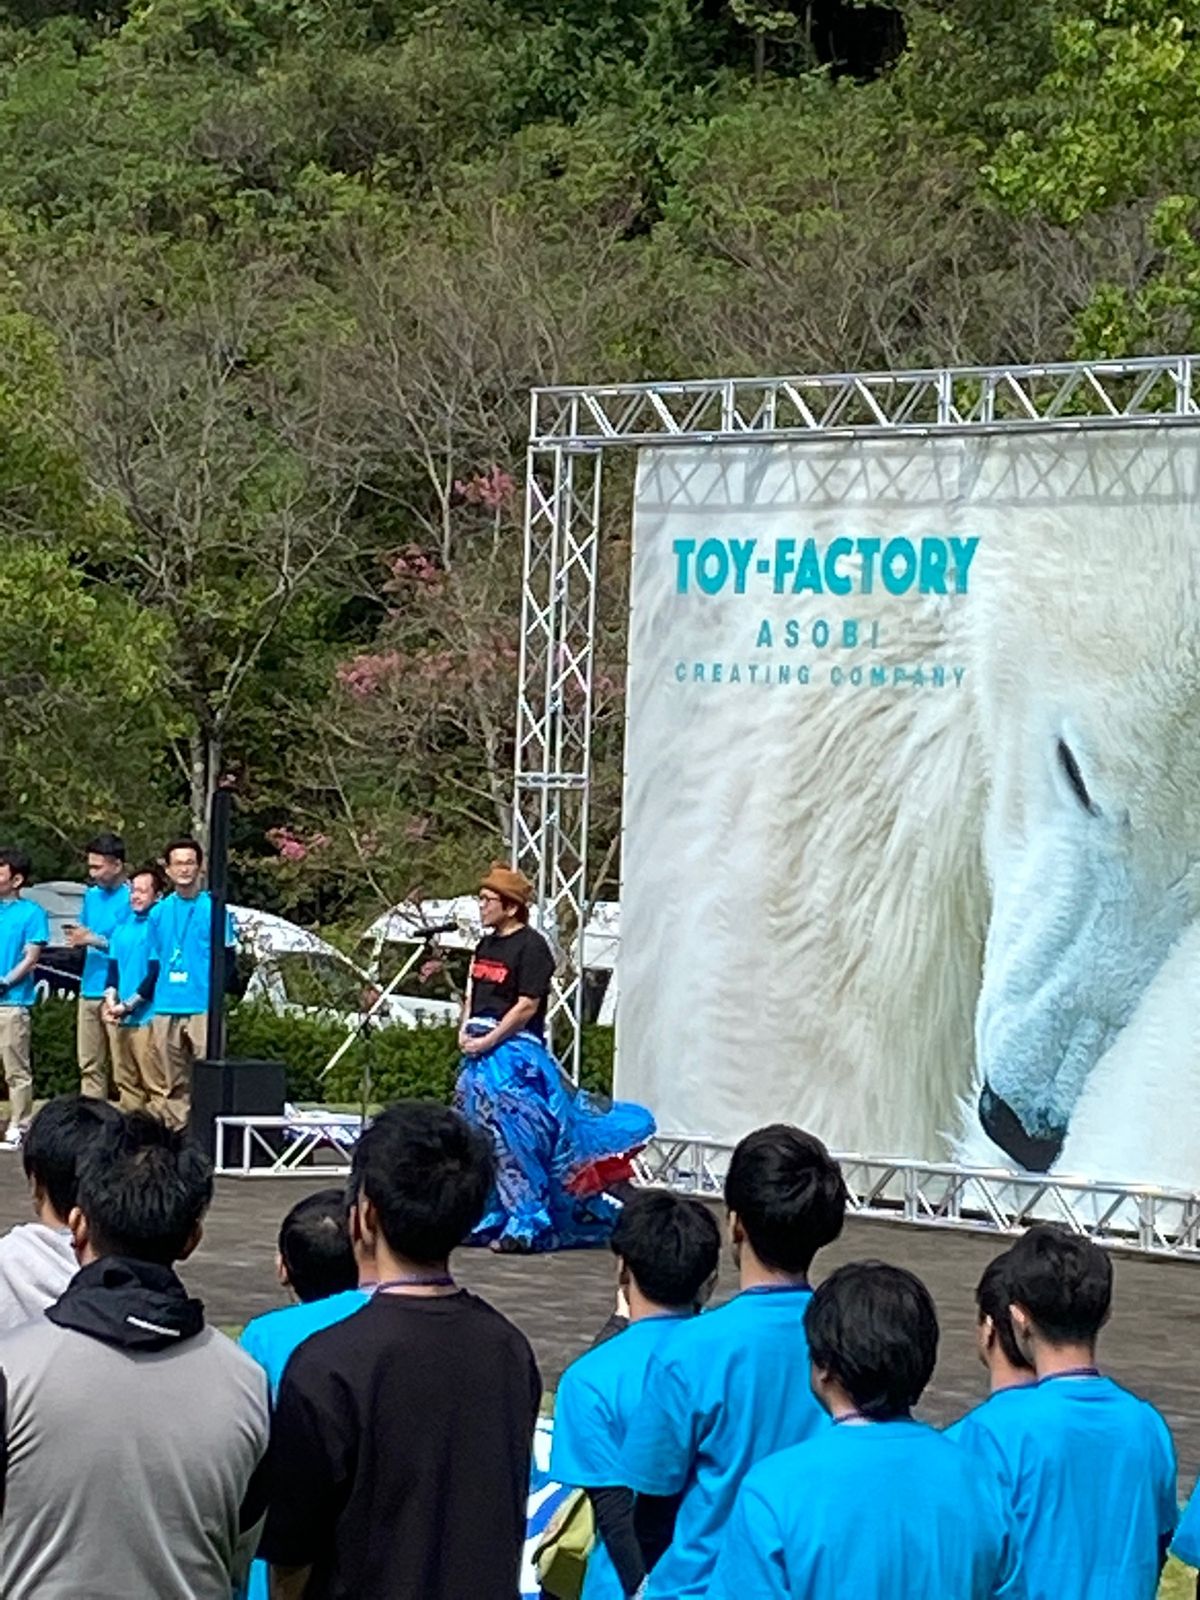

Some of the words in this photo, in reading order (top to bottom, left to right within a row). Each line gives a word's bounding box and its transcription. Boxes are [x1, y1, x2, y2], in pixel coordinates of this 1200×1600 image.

[672, 537, 981, 596] TOY-FACTORY
[756, 618, 880, 649] ASOBI
[674, 662, 810, 685] CREATING
[830, 664, 966, 688] COMPANY
